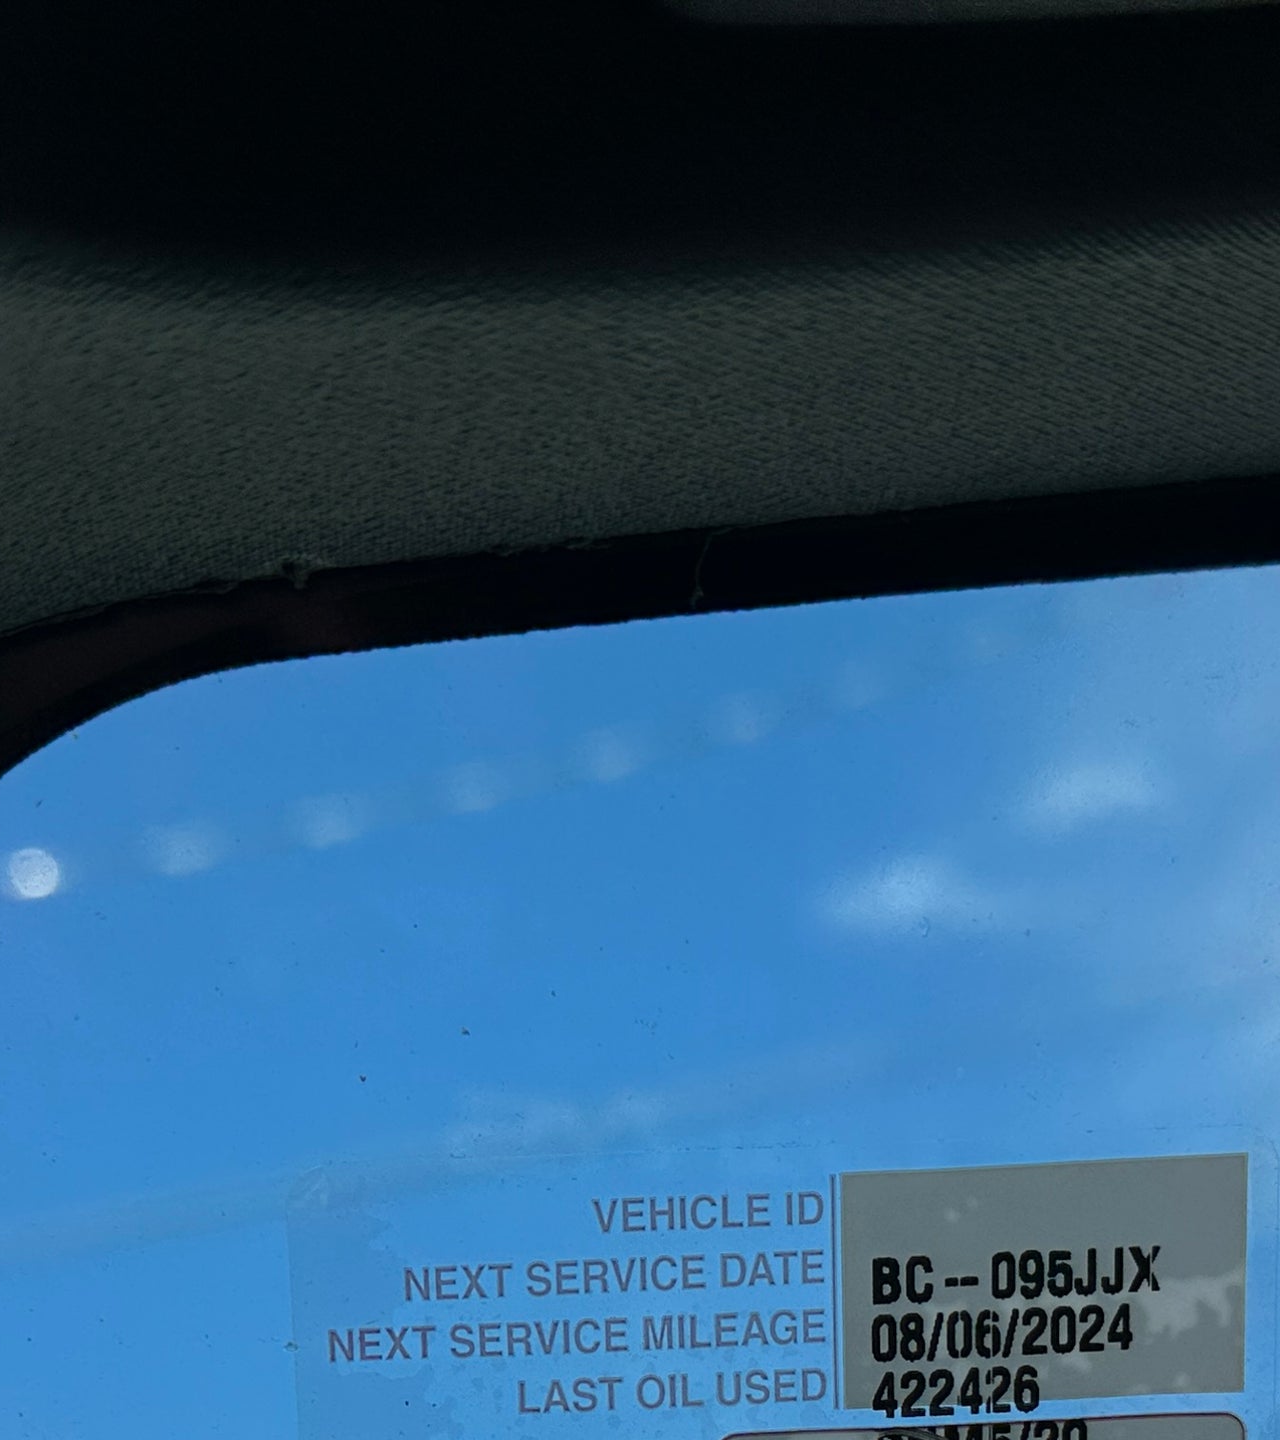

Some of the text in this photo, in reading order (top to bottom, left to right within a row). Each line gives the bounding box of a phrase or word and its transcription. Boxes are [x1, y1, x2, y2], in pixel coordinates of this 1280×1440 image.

[591, 1190, 824, 1234] VEHICLE ID
[403, 1248, 825, 1302] NEXT SERVICE DATE
[327, 1307, 826, 1363] NEXT SERVICE MILEAGE
[871, 1303, 1134, 1363] 08/06/2024
[516, 1367, 828, 1416] LAST OIL USED
[872, 1364, 1041, 1419] 422426
